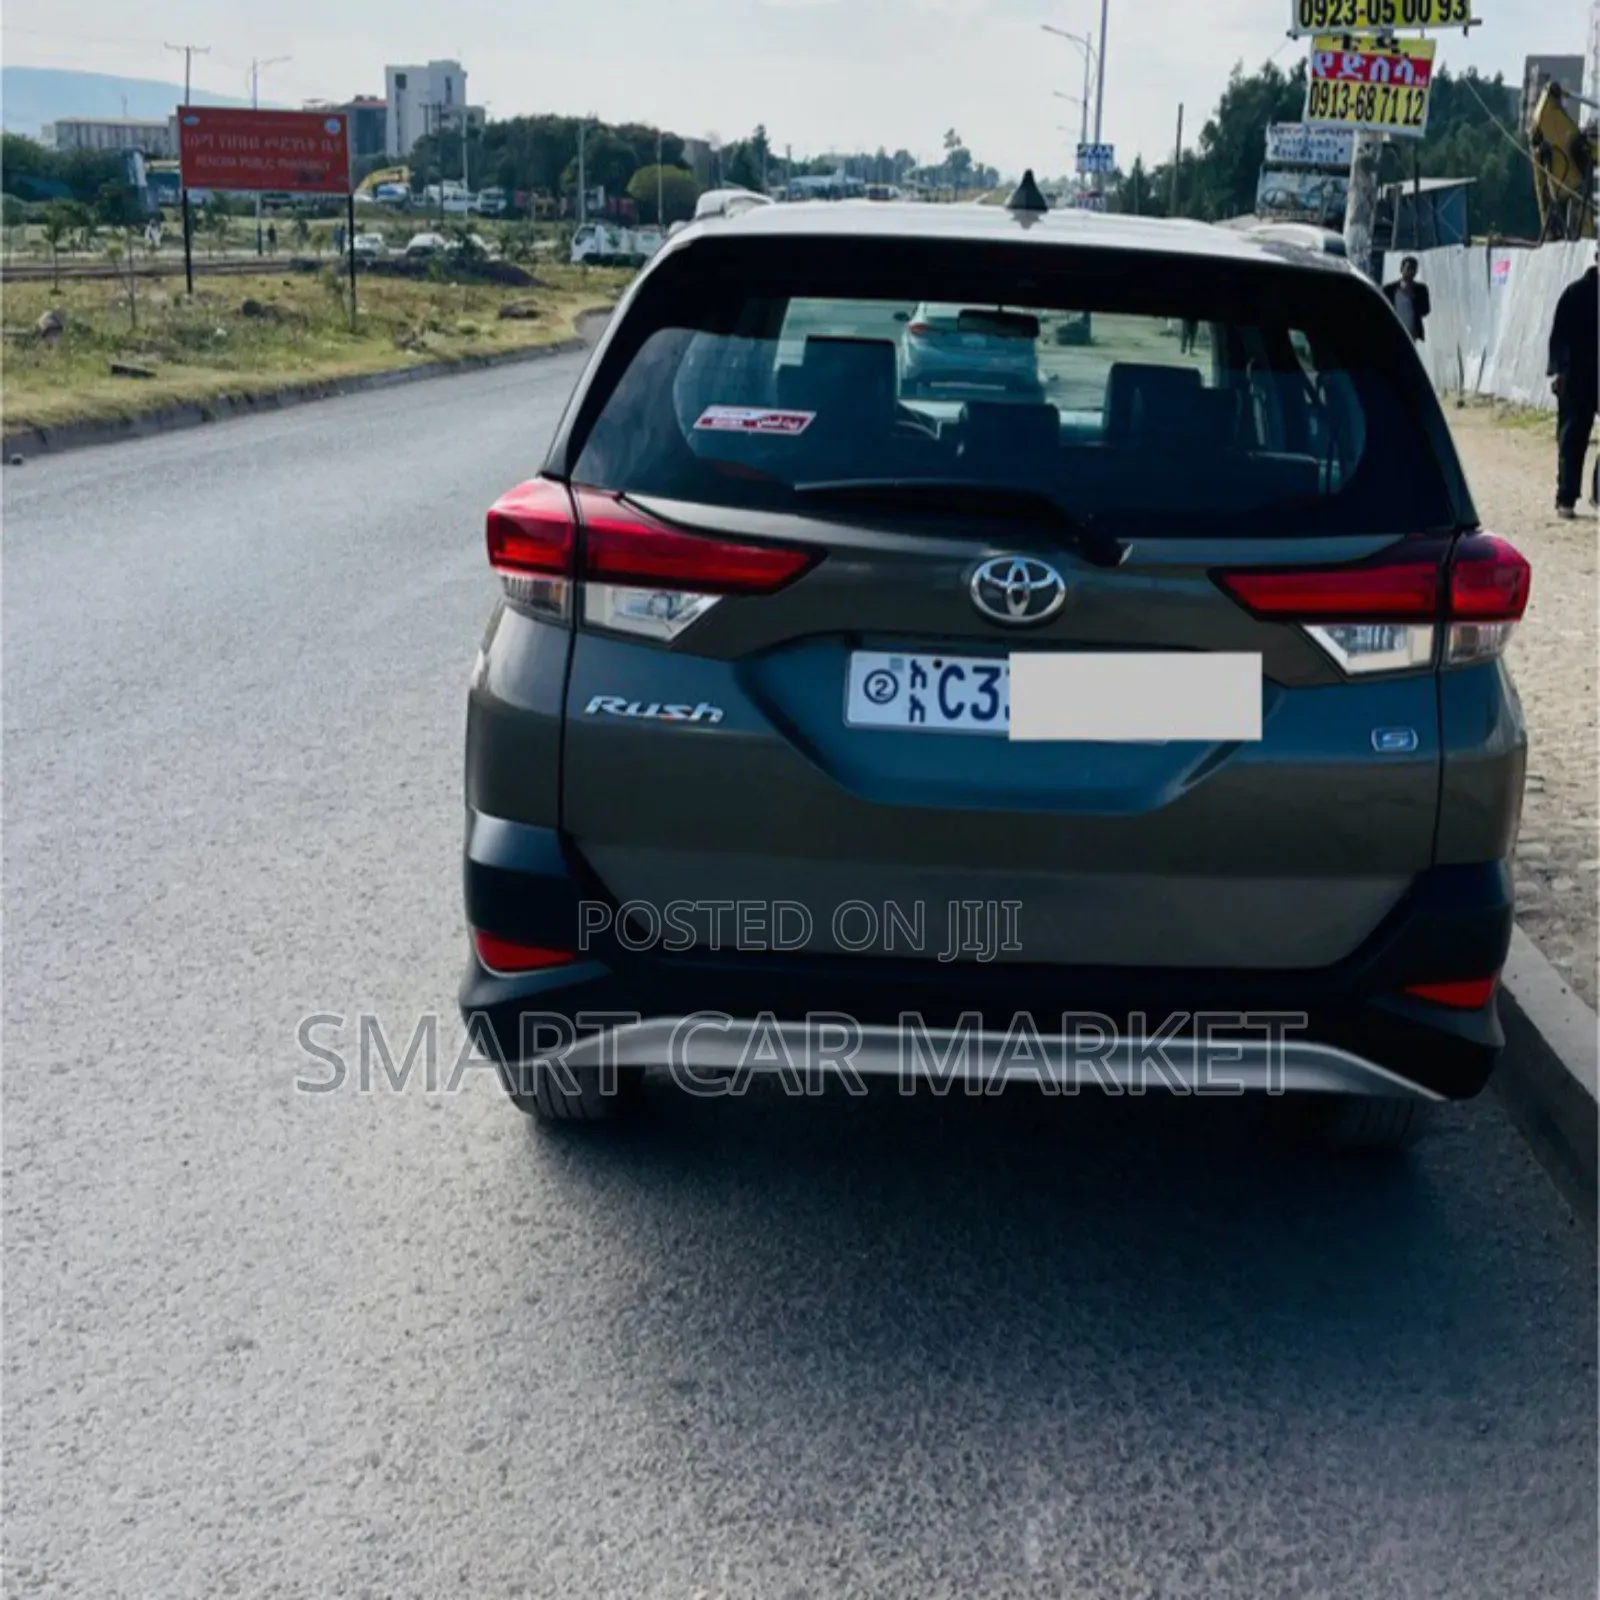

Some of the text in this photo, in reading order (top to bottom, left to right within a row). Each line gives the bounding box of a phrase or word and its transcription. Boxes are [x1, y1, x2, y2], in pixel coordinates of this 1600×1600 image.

[1308, 81, 1425, 125] 0913-68 71 12
[584, 694, 724, 724] Rush
[938, 664, 1009, 722] C3
